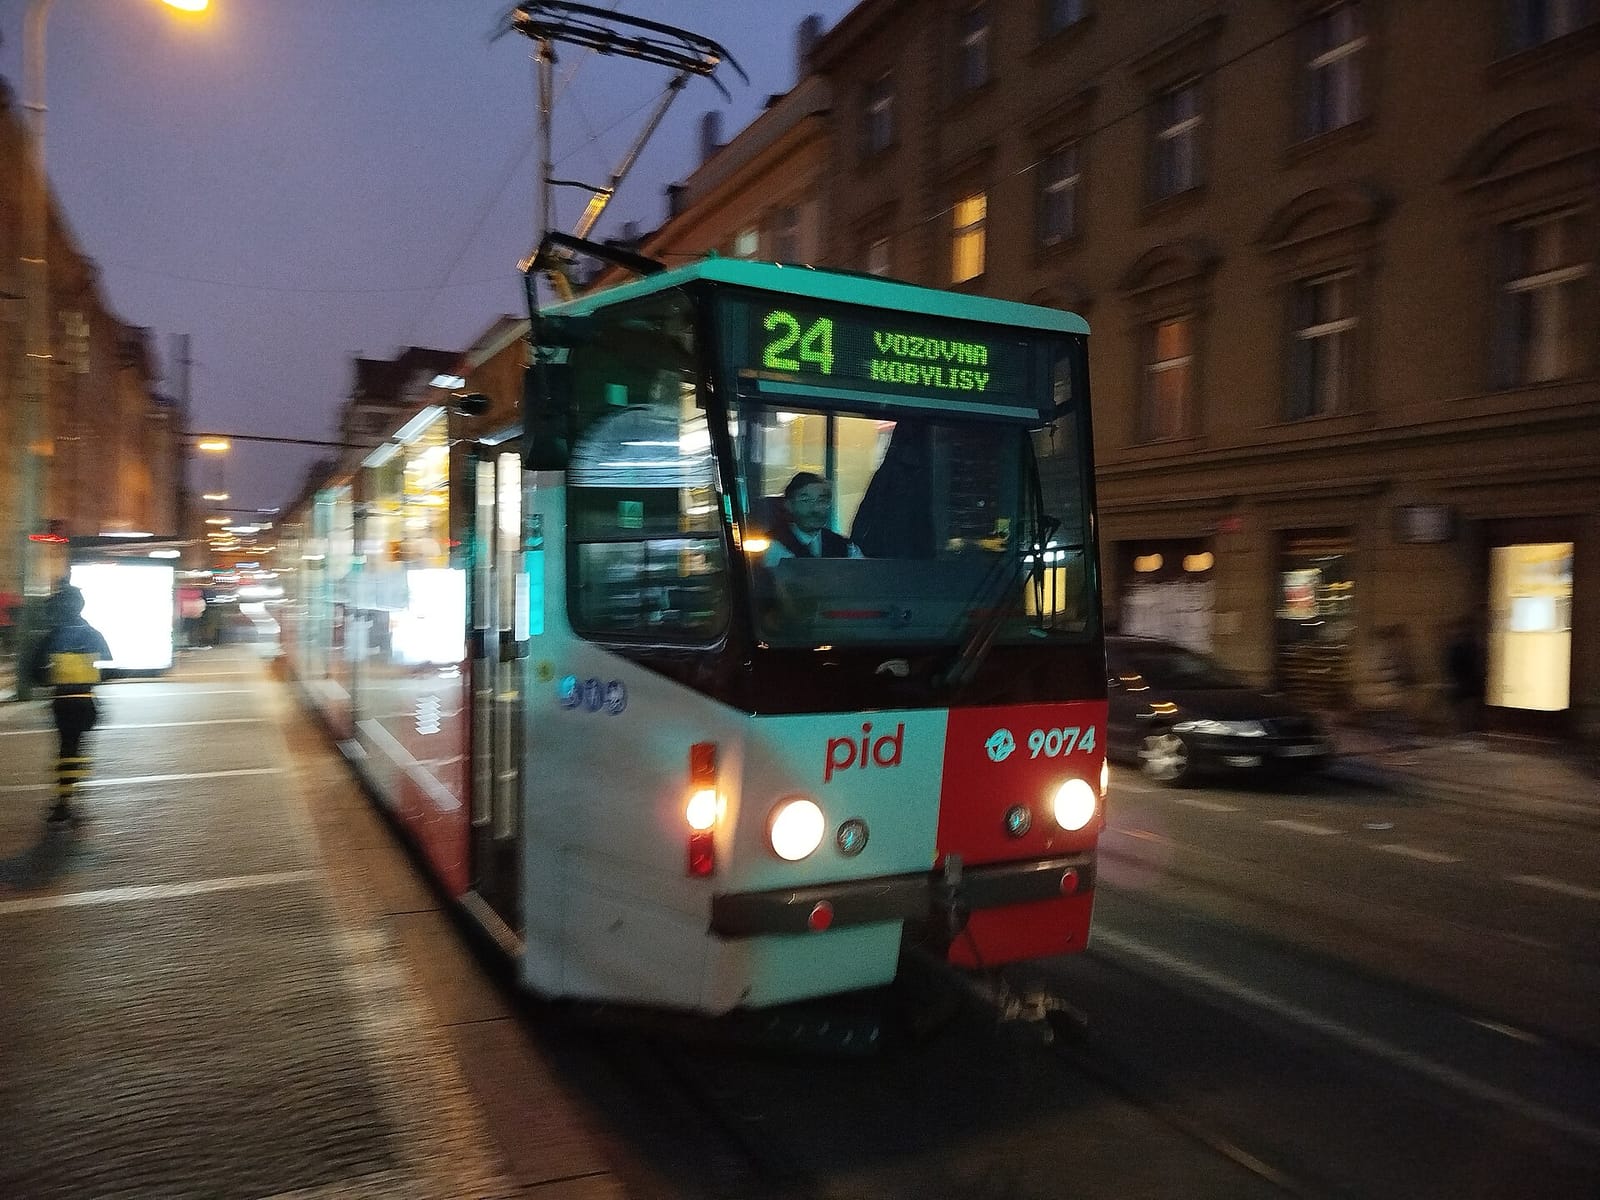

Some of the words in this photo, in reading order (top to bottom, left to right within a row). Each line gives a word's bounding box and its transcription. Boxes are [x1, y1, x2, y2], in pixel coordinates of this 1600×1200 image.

[763, 310, 834, 375] 24
[873, 331, 988, 366] VOZOVNA
[870, 358, 990, 392] KOBYLISY
[824, 722, 905, 784] pid
[1027, 725, 1096, 760] 9074
